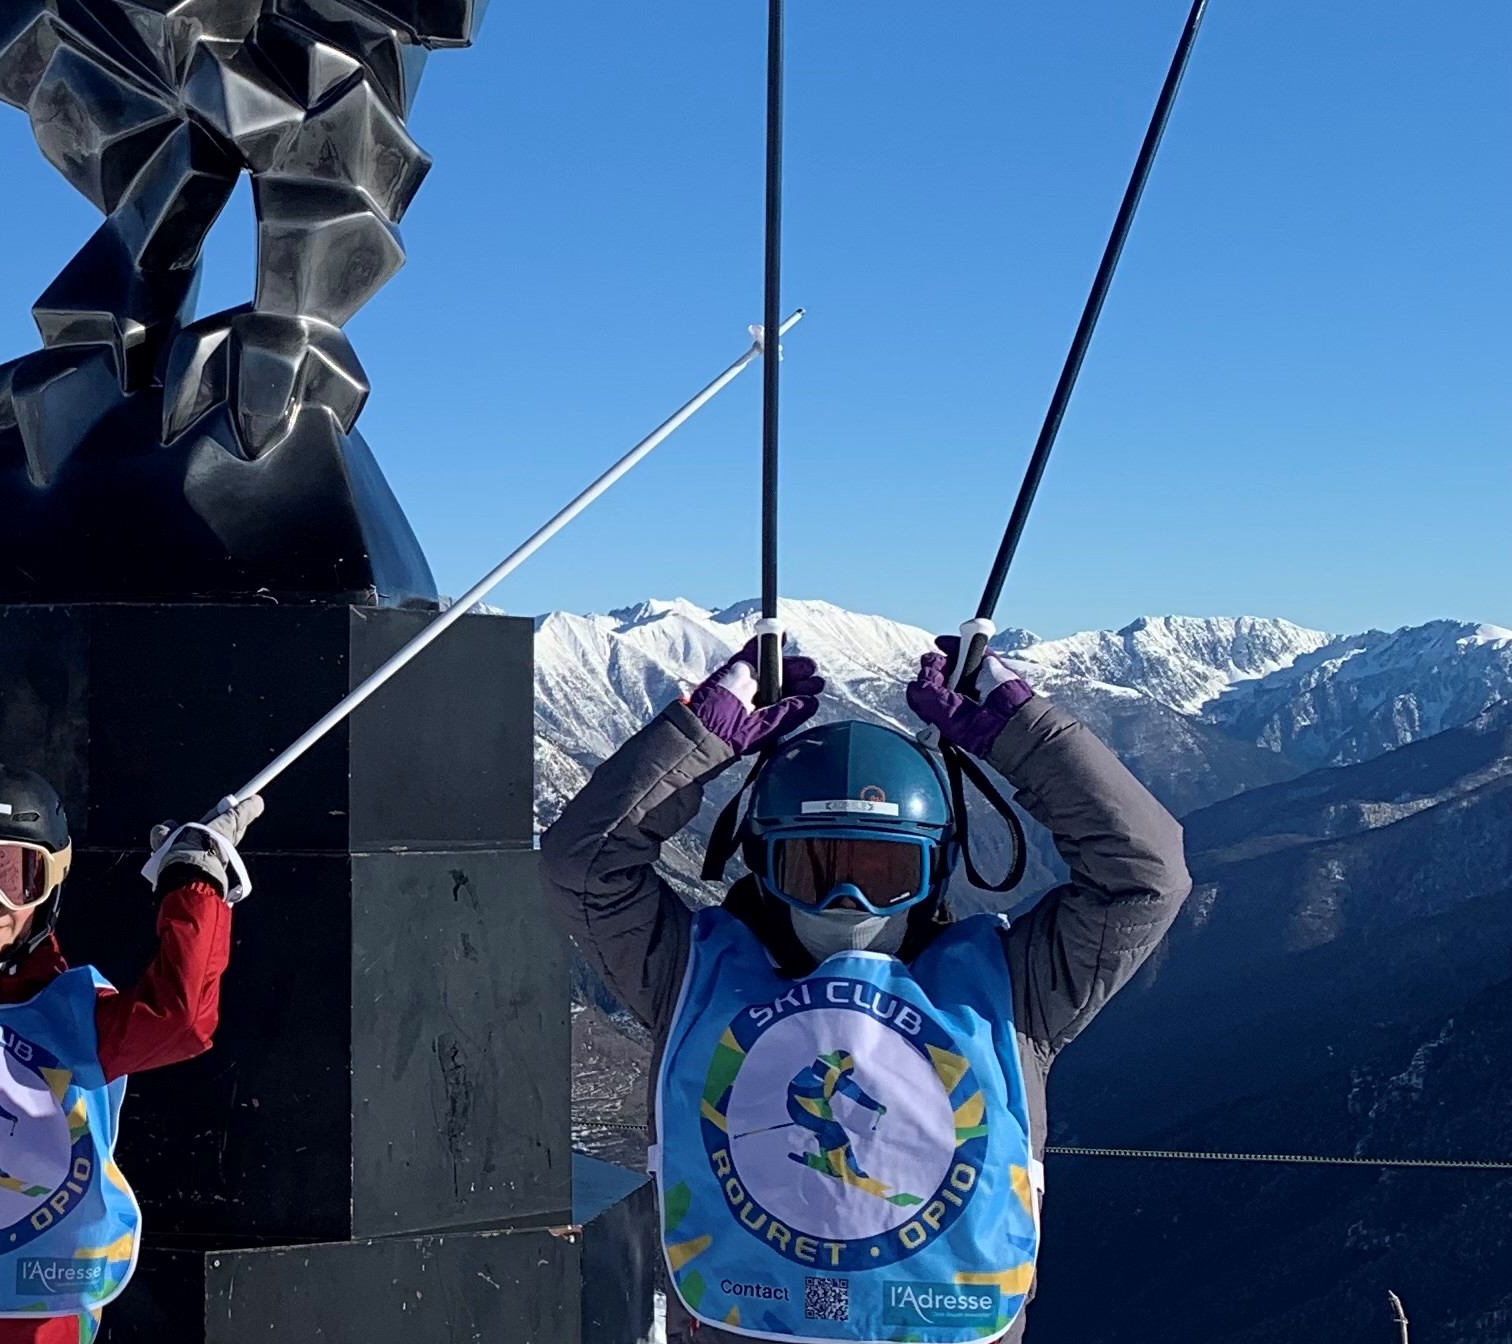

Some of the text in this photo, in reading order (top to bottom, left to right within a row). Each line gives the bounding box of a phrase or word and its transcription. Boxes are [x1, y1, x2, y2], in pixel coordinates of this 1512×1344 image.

[749, 981, 922, 1036] SKI CLUB
[30, 1156, 91, 1230] OPIO
[712, 1148, 976, 1266] ROURET OPIO
[22, 1261, 102, 1293] l'Adresse
[720, 1278, 790, 1301] Contact
[891, 1285, 993, 1324] l'Adresse
